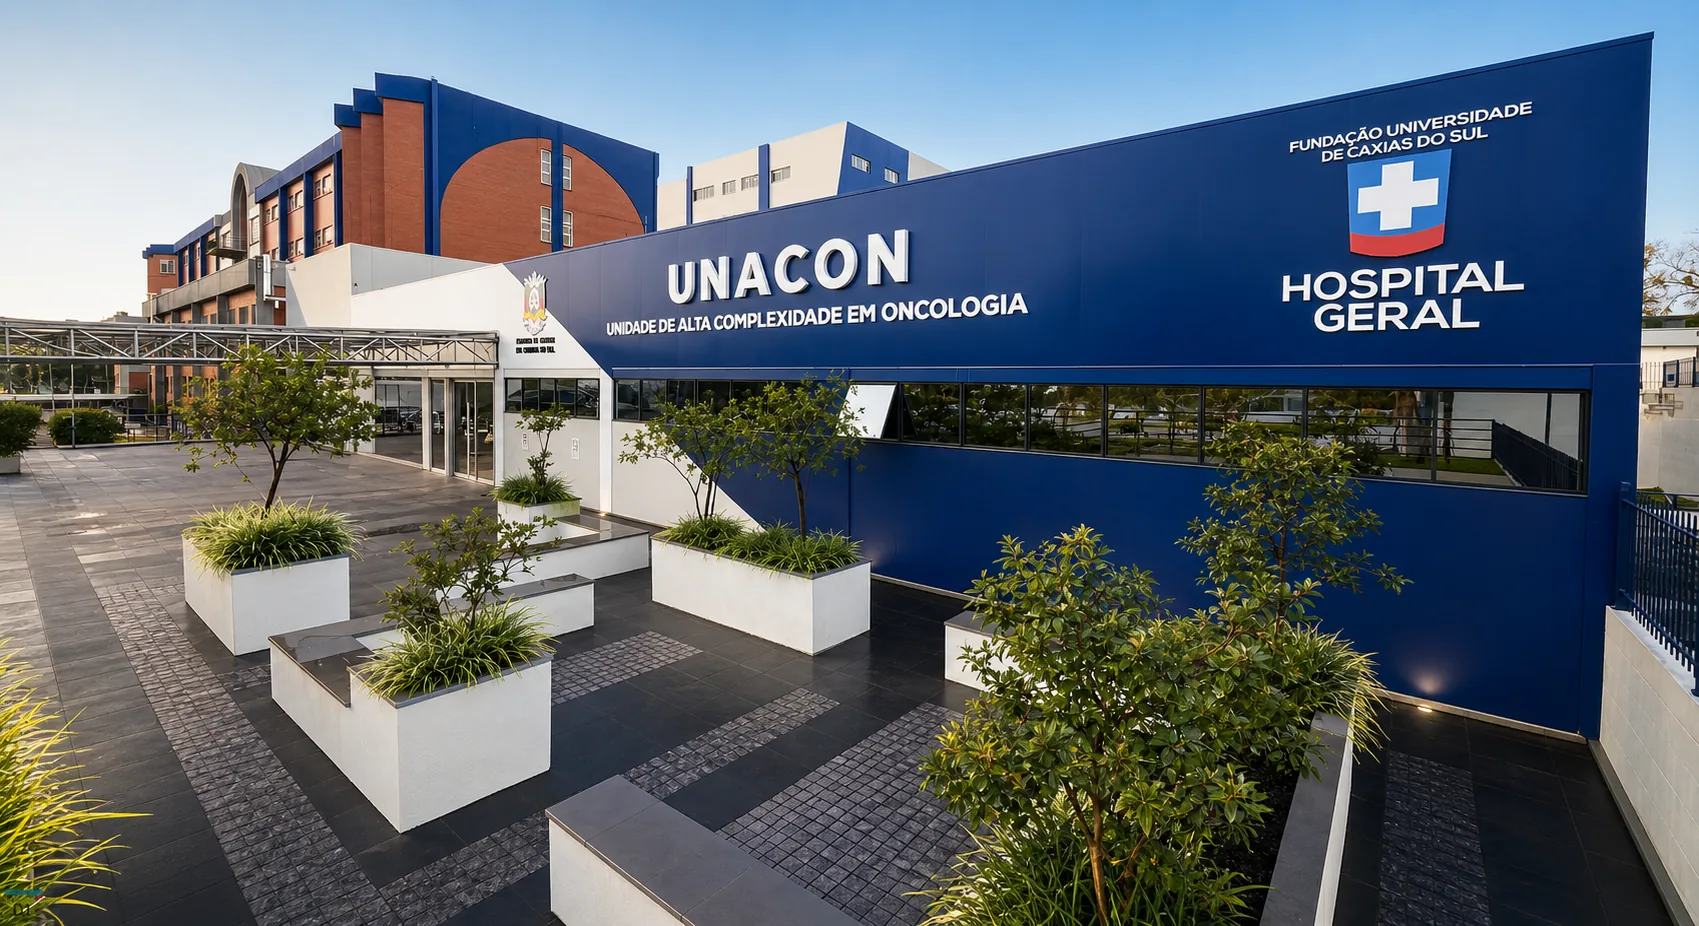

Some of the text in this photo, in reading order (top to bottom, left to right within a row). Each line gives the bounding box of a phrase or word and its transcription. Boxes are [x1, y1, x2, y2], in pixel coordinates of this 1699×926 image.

[1289, 101, 1533, 153] FUNDAÇÃO UNIVERSIDADE
[1321, 126, 1488, 163] DE CAXIAS DO SUL
[668, 229, 909, 304] UNACON
[1282, 260, 1525, 302] HOSPITAL
[606, 293, 1029, 336] UNIDADE DE ALTA COMPLEXIDADE EM ONCOLOGIA
[1313, 298, 1480, 332] GERAL
